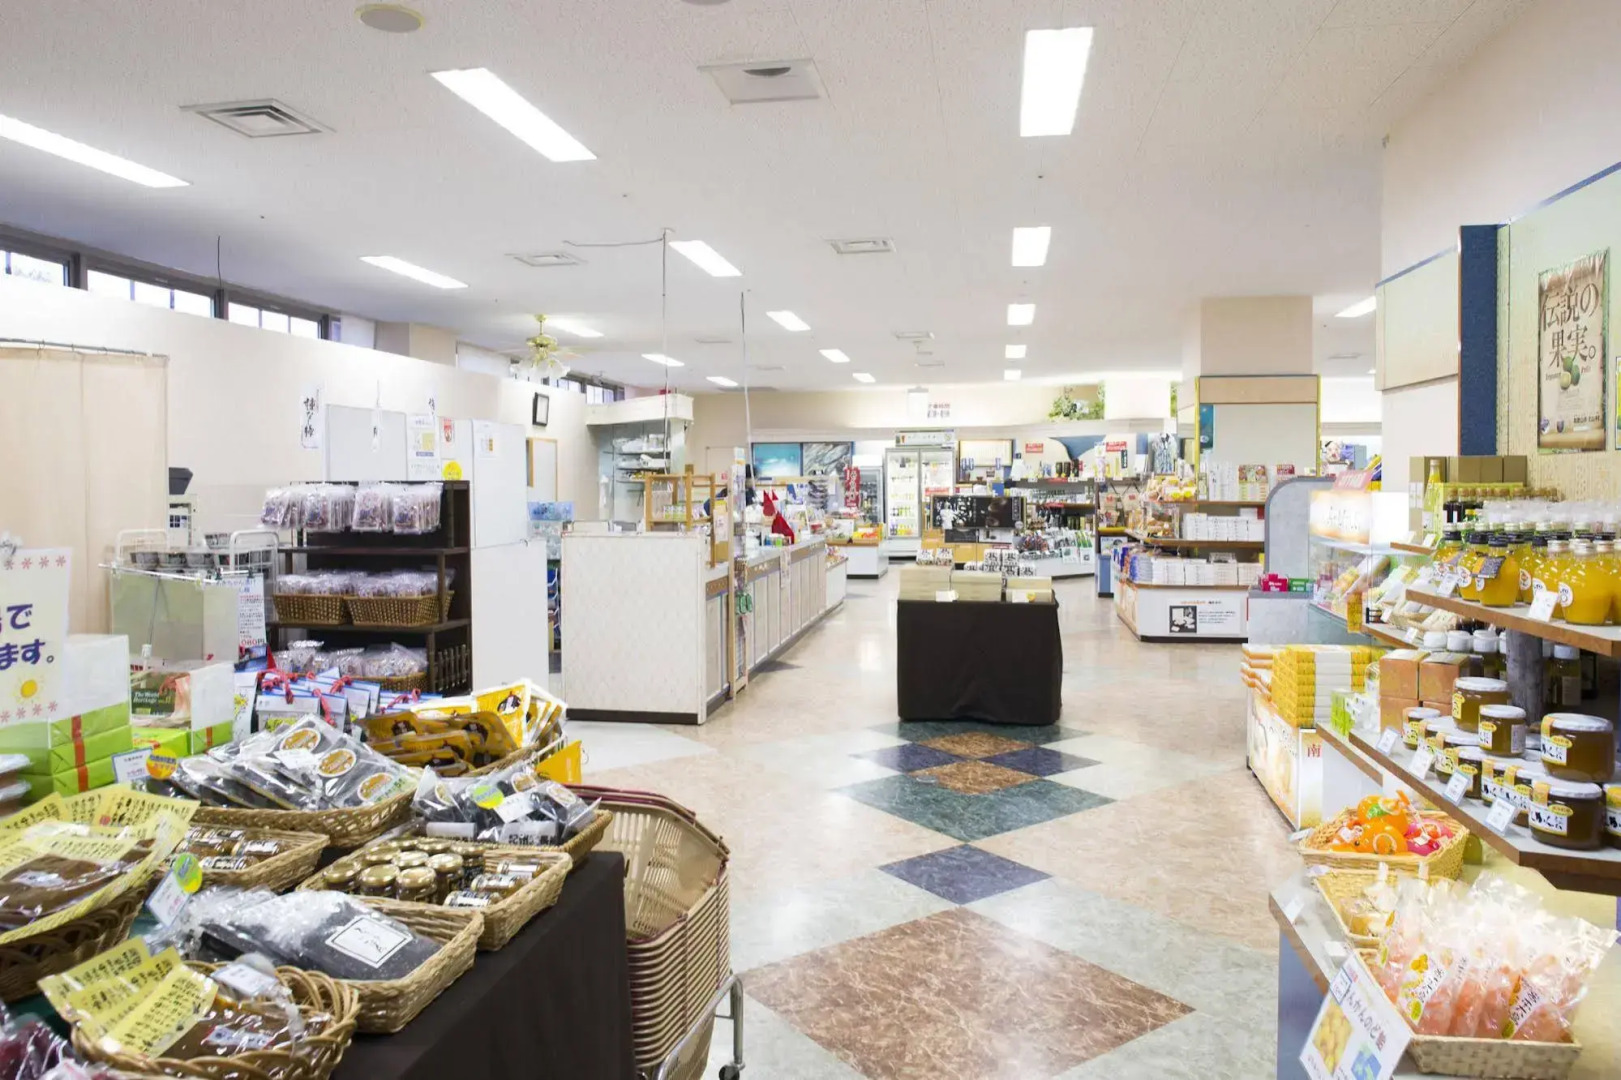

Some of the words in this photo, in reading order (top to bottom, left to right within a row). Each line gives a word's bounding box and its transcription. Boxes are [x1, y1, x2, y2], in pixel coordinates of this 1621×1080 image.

[1542, 282, 1599, 332] 伝説の
[1548, 323, 1597, 368] 果実。
[0, 603, 33, 633] で
[0, 638, 55, 671] ます。
